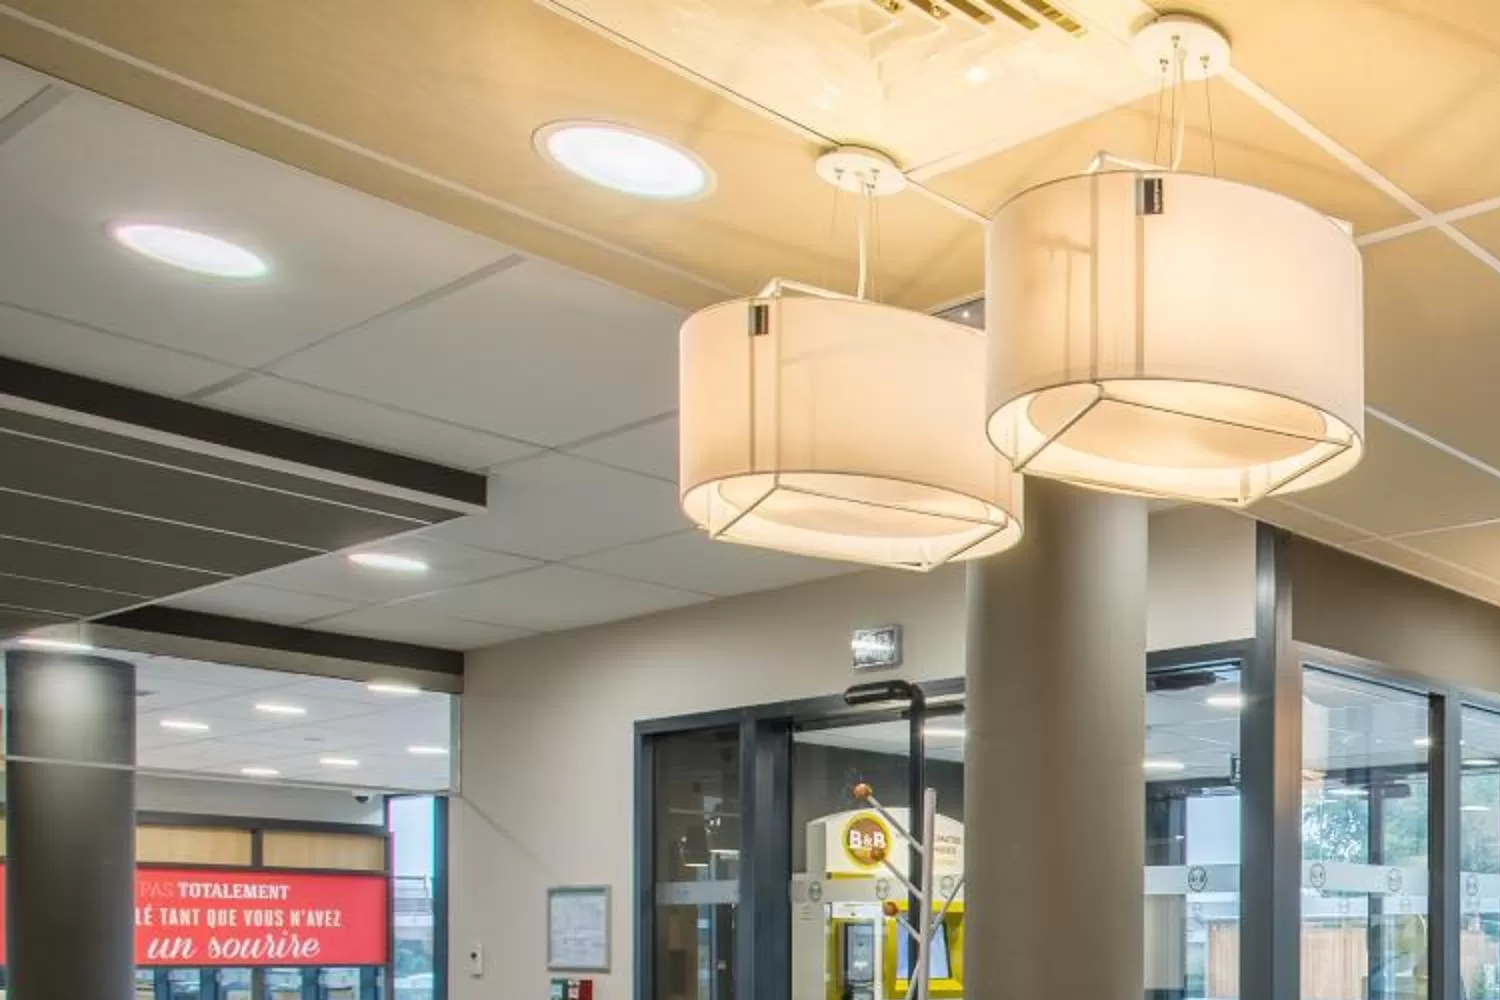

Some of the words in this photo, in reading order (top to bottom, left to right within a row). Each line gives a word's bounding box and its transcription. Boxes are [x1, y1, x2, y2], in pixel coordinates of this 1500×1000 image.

[140, 883, 174, 897] PAS
[177, 881, 291, 900] TOTALEMENT
[135, 904, 152, 926] LÉ
[160, 908, 201, 927] TANT
[207, 908, 237, 928] QUE
[244, 909, 285, 927] VOUS
[290, 909, 342, 928] N'AVEZ
[147, 937, 196, 959] un
[207, 930, 321, 959] sourire
